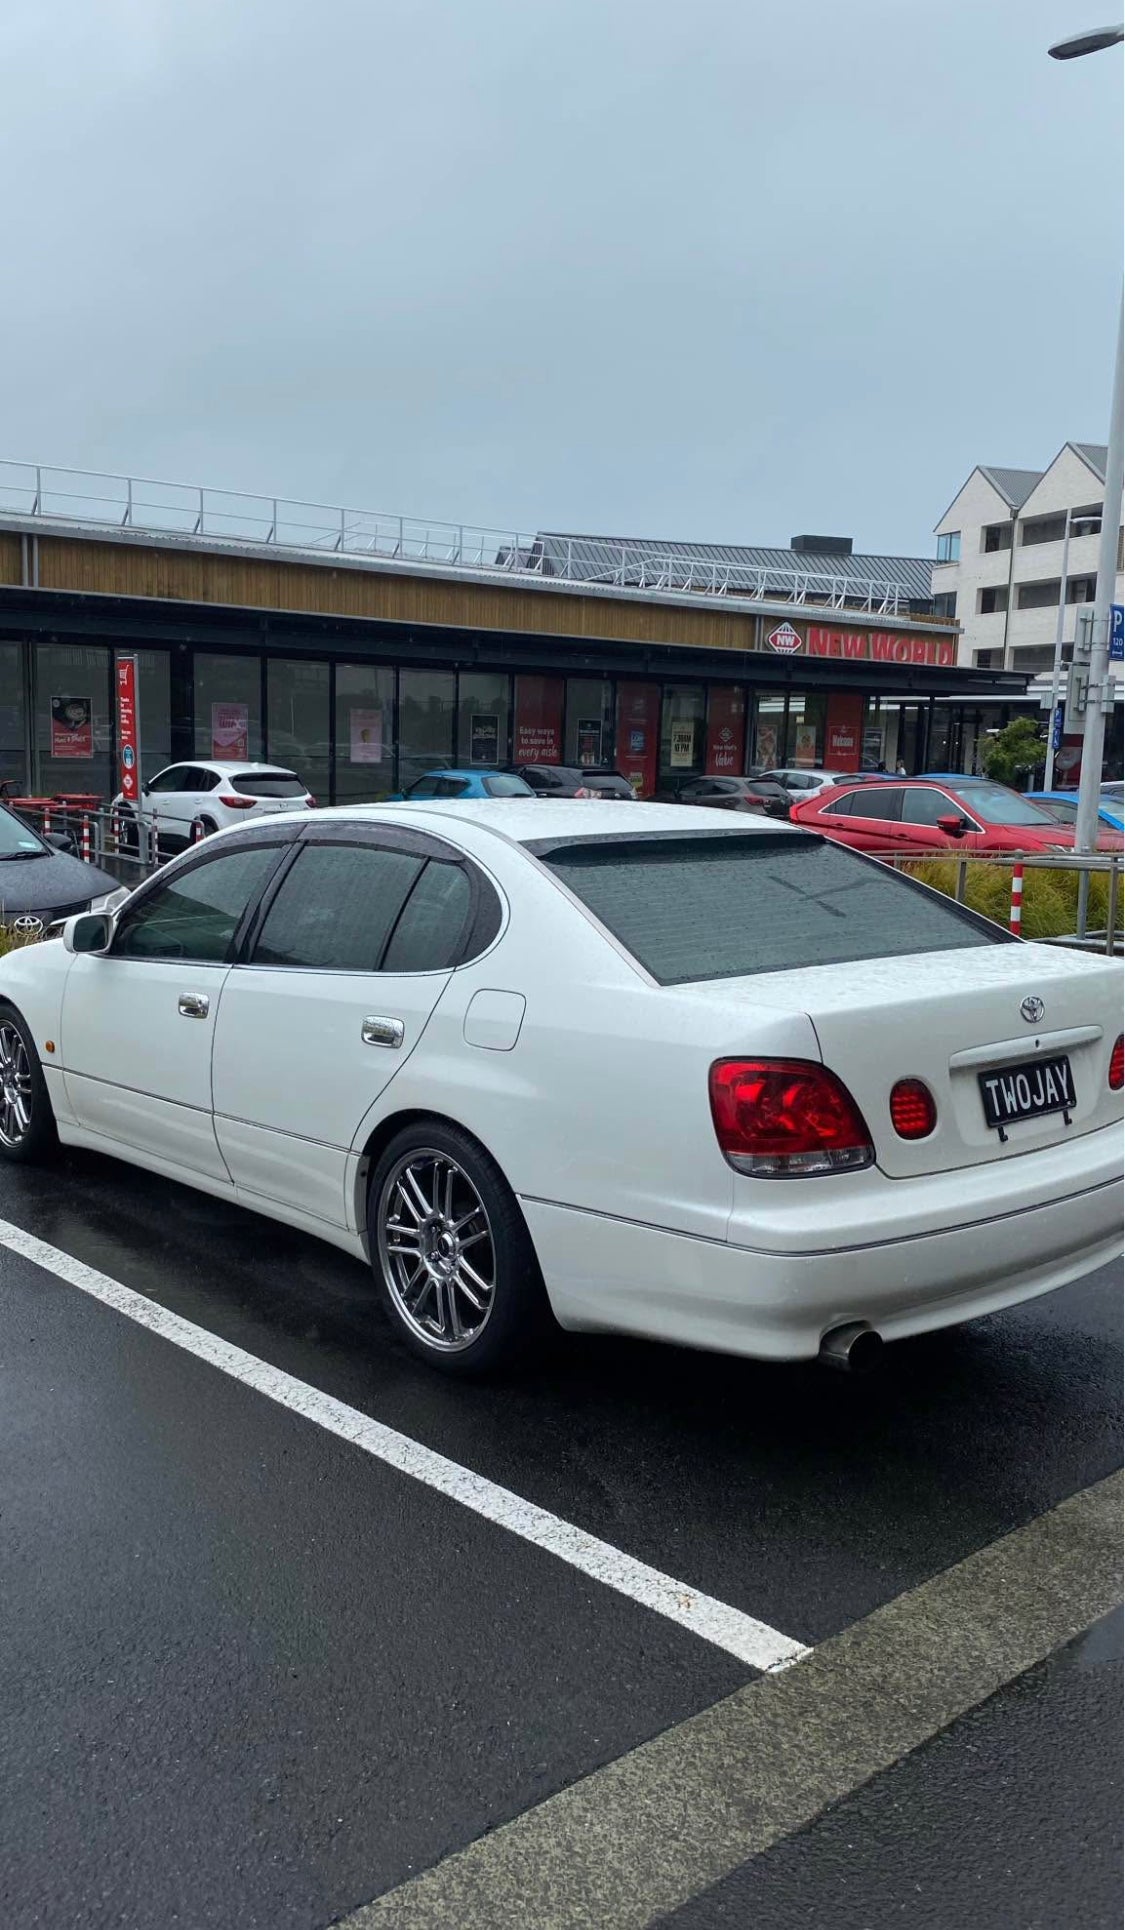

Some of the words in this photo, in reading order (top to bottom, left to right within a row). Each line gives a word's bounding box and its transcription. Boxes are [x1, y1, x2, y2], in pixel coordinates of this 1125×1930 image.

[1113, 610, 1122, 632] P
[776, 634, 795, 646] NW
[806, 626, 867, 659] NEW
[869, 632, 954, 667] WORLD
[519, 726, 536, 736] Easy
[521, 737, 529, 745] to
[547, 736, 554, 745] in
[519, 747, 540, 762] every
[985, 1064, 1069, 1116] TWOJAY
